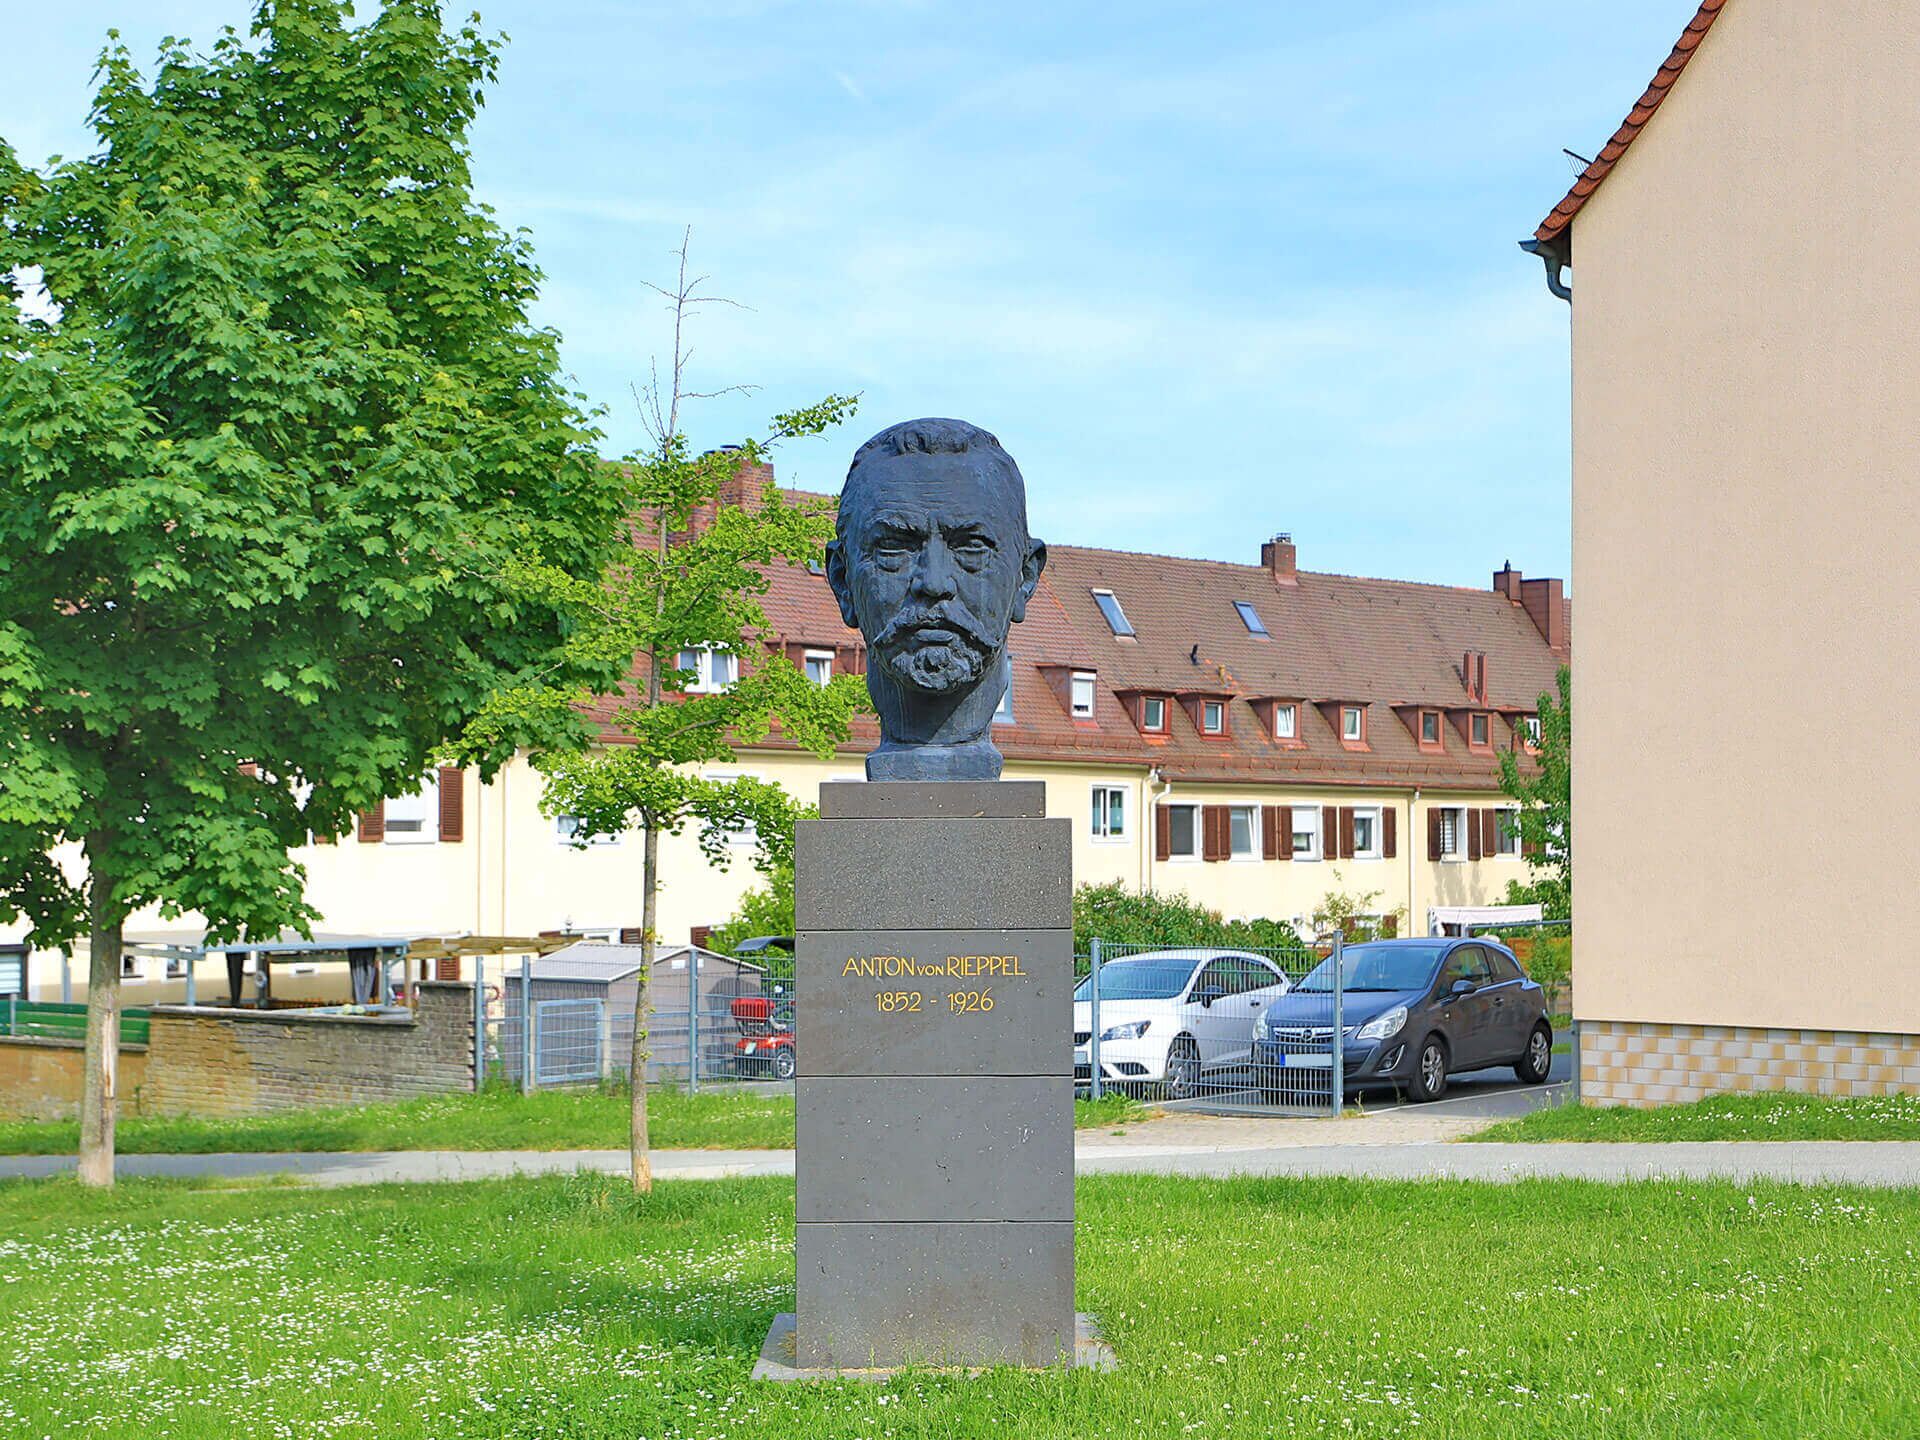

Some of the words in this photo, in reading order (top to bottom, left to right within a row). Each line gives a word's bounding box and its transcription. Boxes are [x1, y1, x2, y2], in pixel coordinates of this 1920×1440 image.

[842, 956, 915, 977] ANTON
[946, 956, 1026, 979] RIEPPEL
[875, 991, 922, 1012] 1852
[947, 987, 994, 1015] 1926
